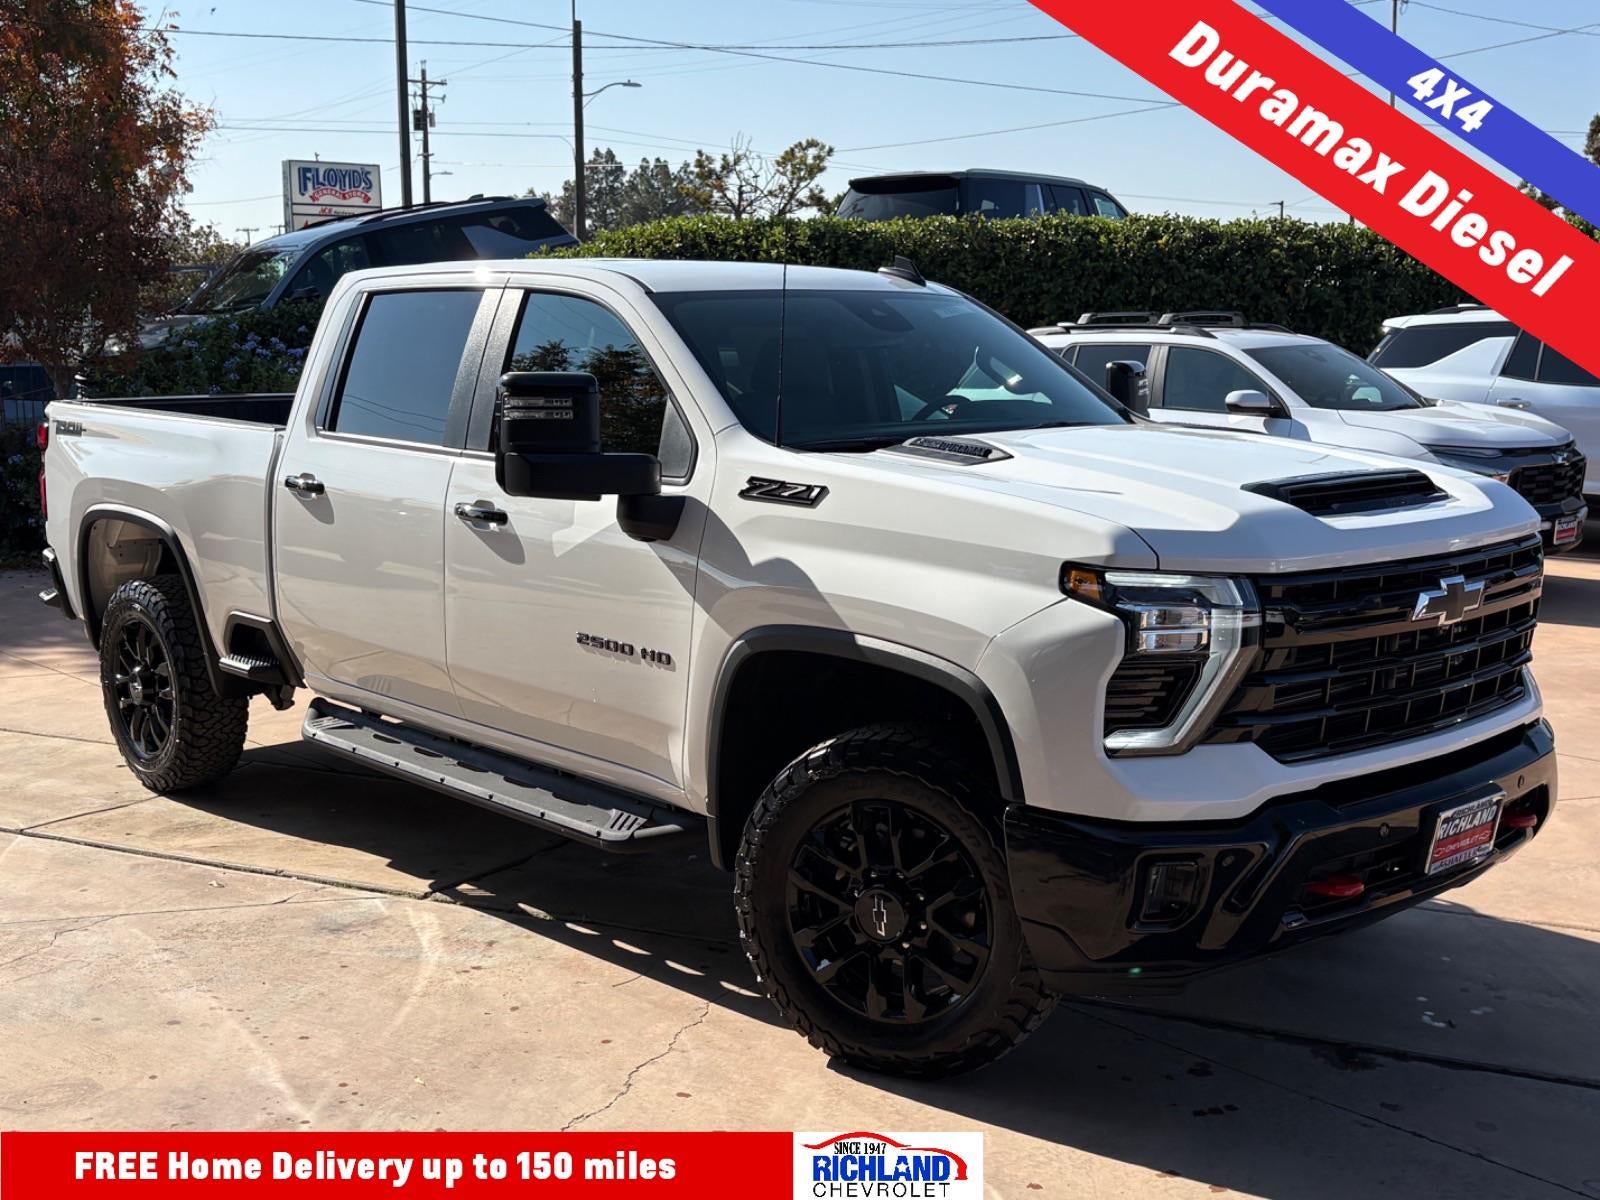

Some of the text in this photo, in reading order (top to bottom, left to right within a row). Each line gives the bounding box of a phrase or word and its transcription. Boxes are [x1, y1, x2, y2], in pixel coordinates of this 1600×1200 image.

[298, 167, 373, 196] FLOYD'S
[314, 188, 343, 200] GENERAL
[319, 207, 333, 215] ACE
[738, 476, 829, 508] Z71
[576, 632, 671, 665] 2500 HD
[1440, 805, 1498, 840] RICHLAND
